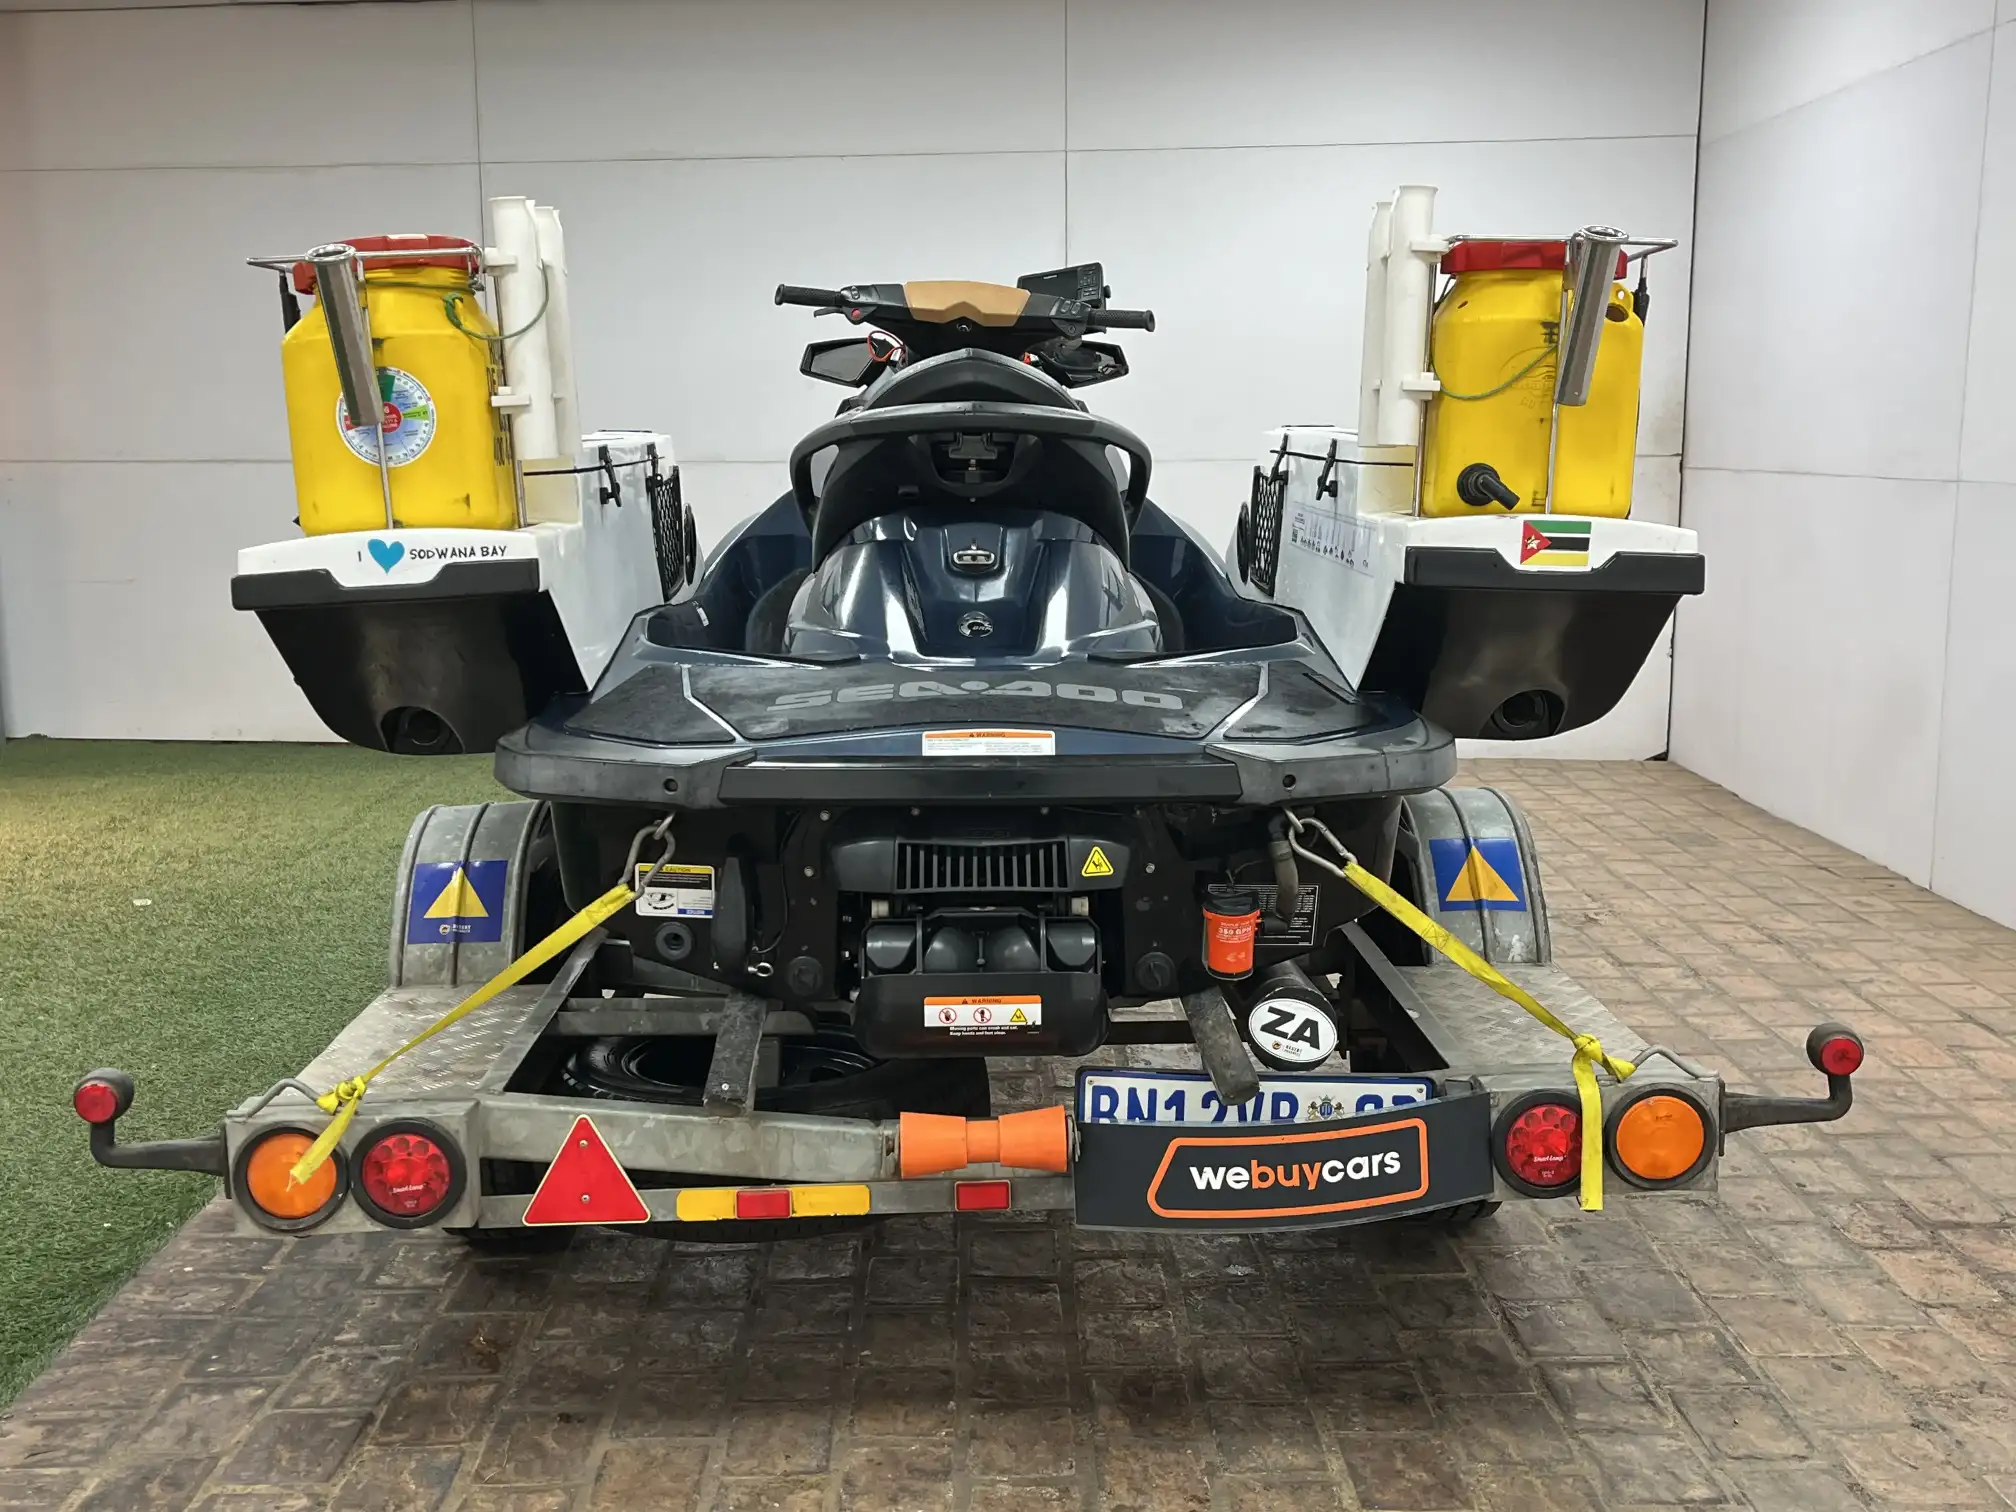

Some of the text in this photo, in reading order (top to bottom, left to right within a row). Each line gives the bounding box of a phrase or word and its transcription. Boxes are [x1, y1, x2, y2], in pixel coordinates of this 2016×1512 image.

[409, 546, 476, 560] SODWANA
[480, 545, 508, 557] BAY
[1260, 1006, 1321, 1051] ZA
[1189, 1151, 1401, 1191] webuycars
